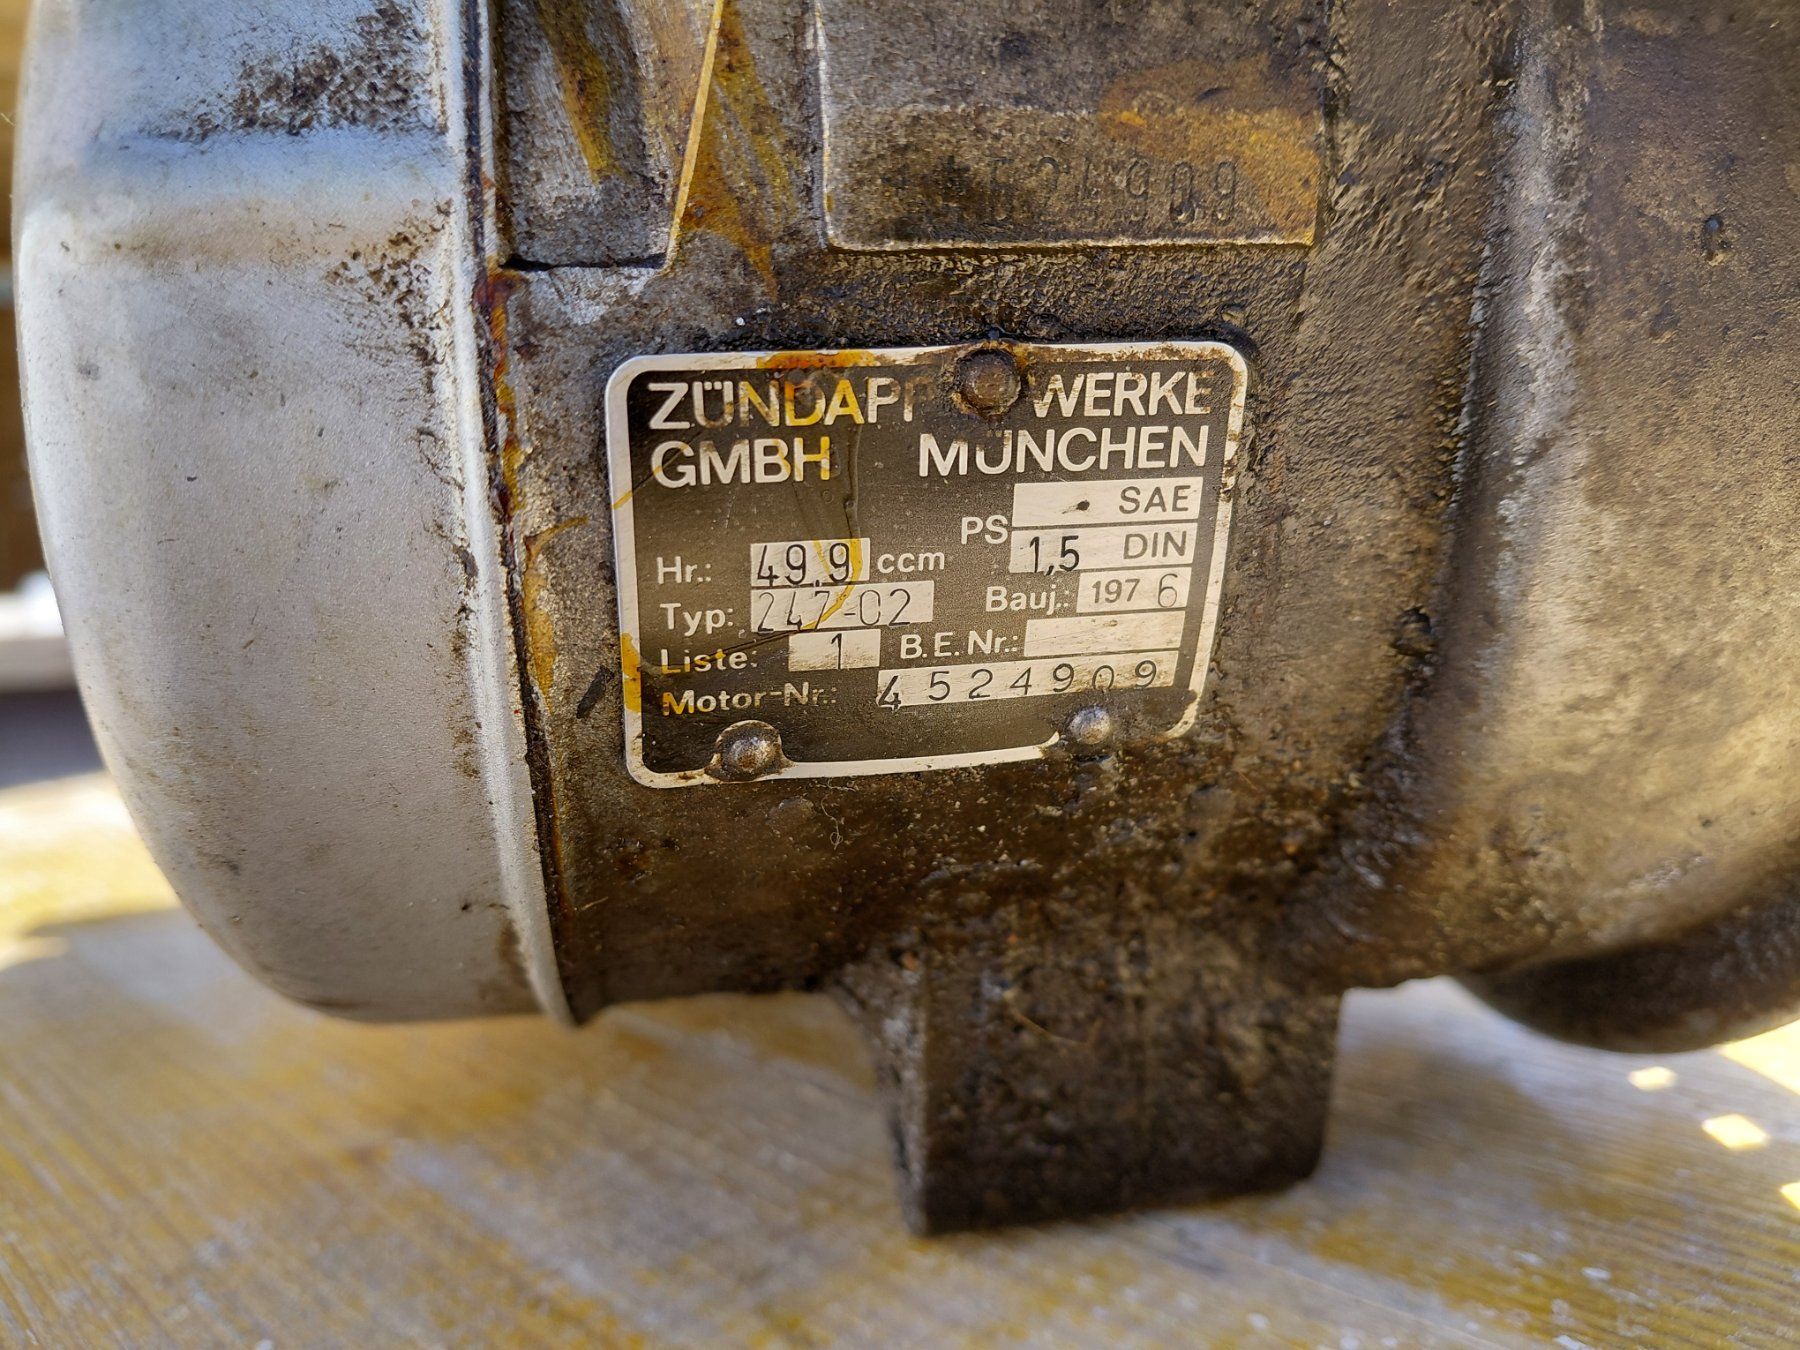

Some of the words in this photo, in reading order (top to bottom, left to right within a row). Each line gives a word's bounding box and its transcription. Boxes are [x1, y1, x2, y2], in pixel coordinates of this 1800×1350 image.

[1033, 370, 1215, 418] WERKE
[651, 436, 831, 489] GMBH
[918, 425, 1209, 477] MÜNCHEN
[1118, 484, 1191, 515] SAE
[961, 514, 1008, 545] PS
[1029, 535, 1080, 576] 1,5
[1123, 530, 1187, 560] DIN
[656, 555, 712, 585] Hr.:
[877, 550, 946, 574] ccm
[660, 602, 733, 637] Typ:
[757, 588, 913, 634] 247-02
[985, 584, 1069, 616] Bauj.:
[661, 648, 758, 674] Liste:
[830, 633, 842, 670] 1
[662, 681, 838, 717] Motor-Nr.:
